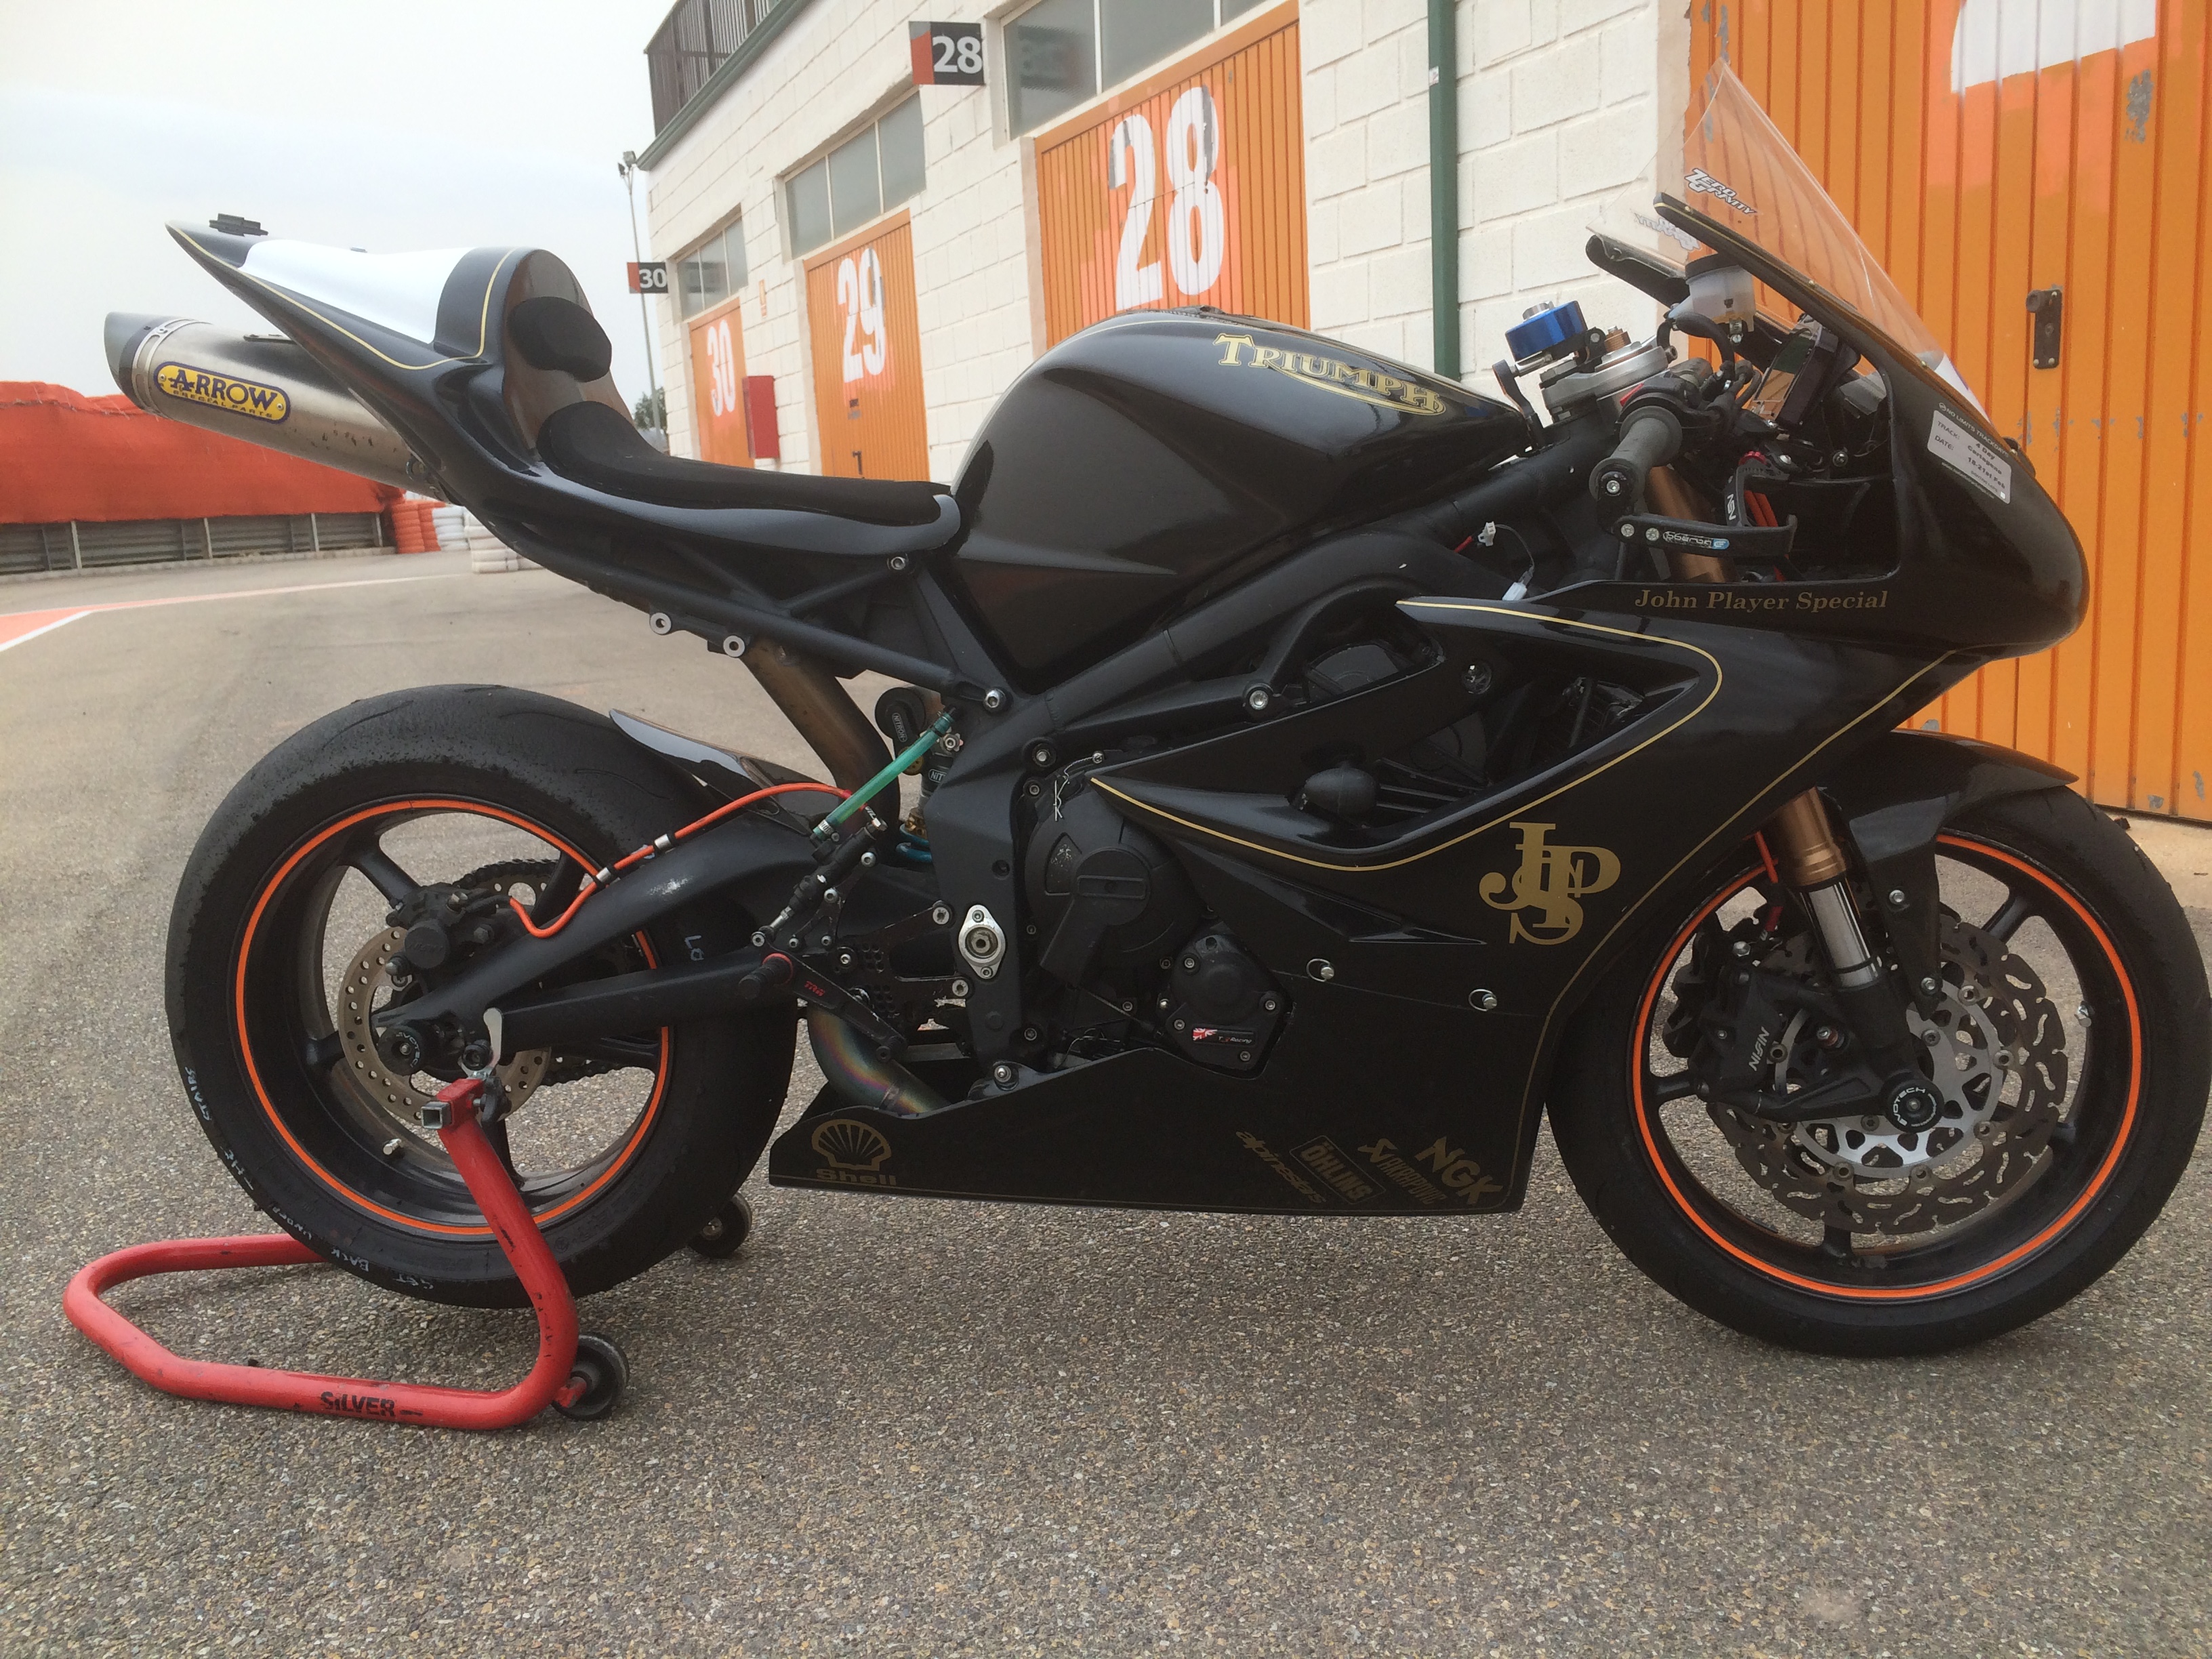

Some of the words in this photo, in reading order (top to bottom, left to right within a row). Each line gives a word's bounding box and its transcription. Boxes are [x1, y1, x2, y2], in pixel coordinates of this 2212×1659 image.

[931, 36, 983, 75] 28
[1109, 85, 1225, 312] 28
[638, 268, 668, 289] 30
[837, 247, 885, 384] 29
[707, 320, 736, 417] 30
[1213, 333, 1443, 413] TRIUMPH
[168, 369, 278, 411] ARROW
[1946, 408, 1956, 417] NO
[1956, 415, 1975, 432] LIMITS
[1982, 447, 1995, 460] Day
[1635, 590, 1697, 608] John
[1706, 591, 1789, 613] Player
[1796, 590, 1888, 613] Special
[930, 771, 946, 781] NIT
[815, 1168, 897, 1187] Shell
[1414, 1136, 1504, 1206] NGK
[331, 1249, 369, 1272] BACK
